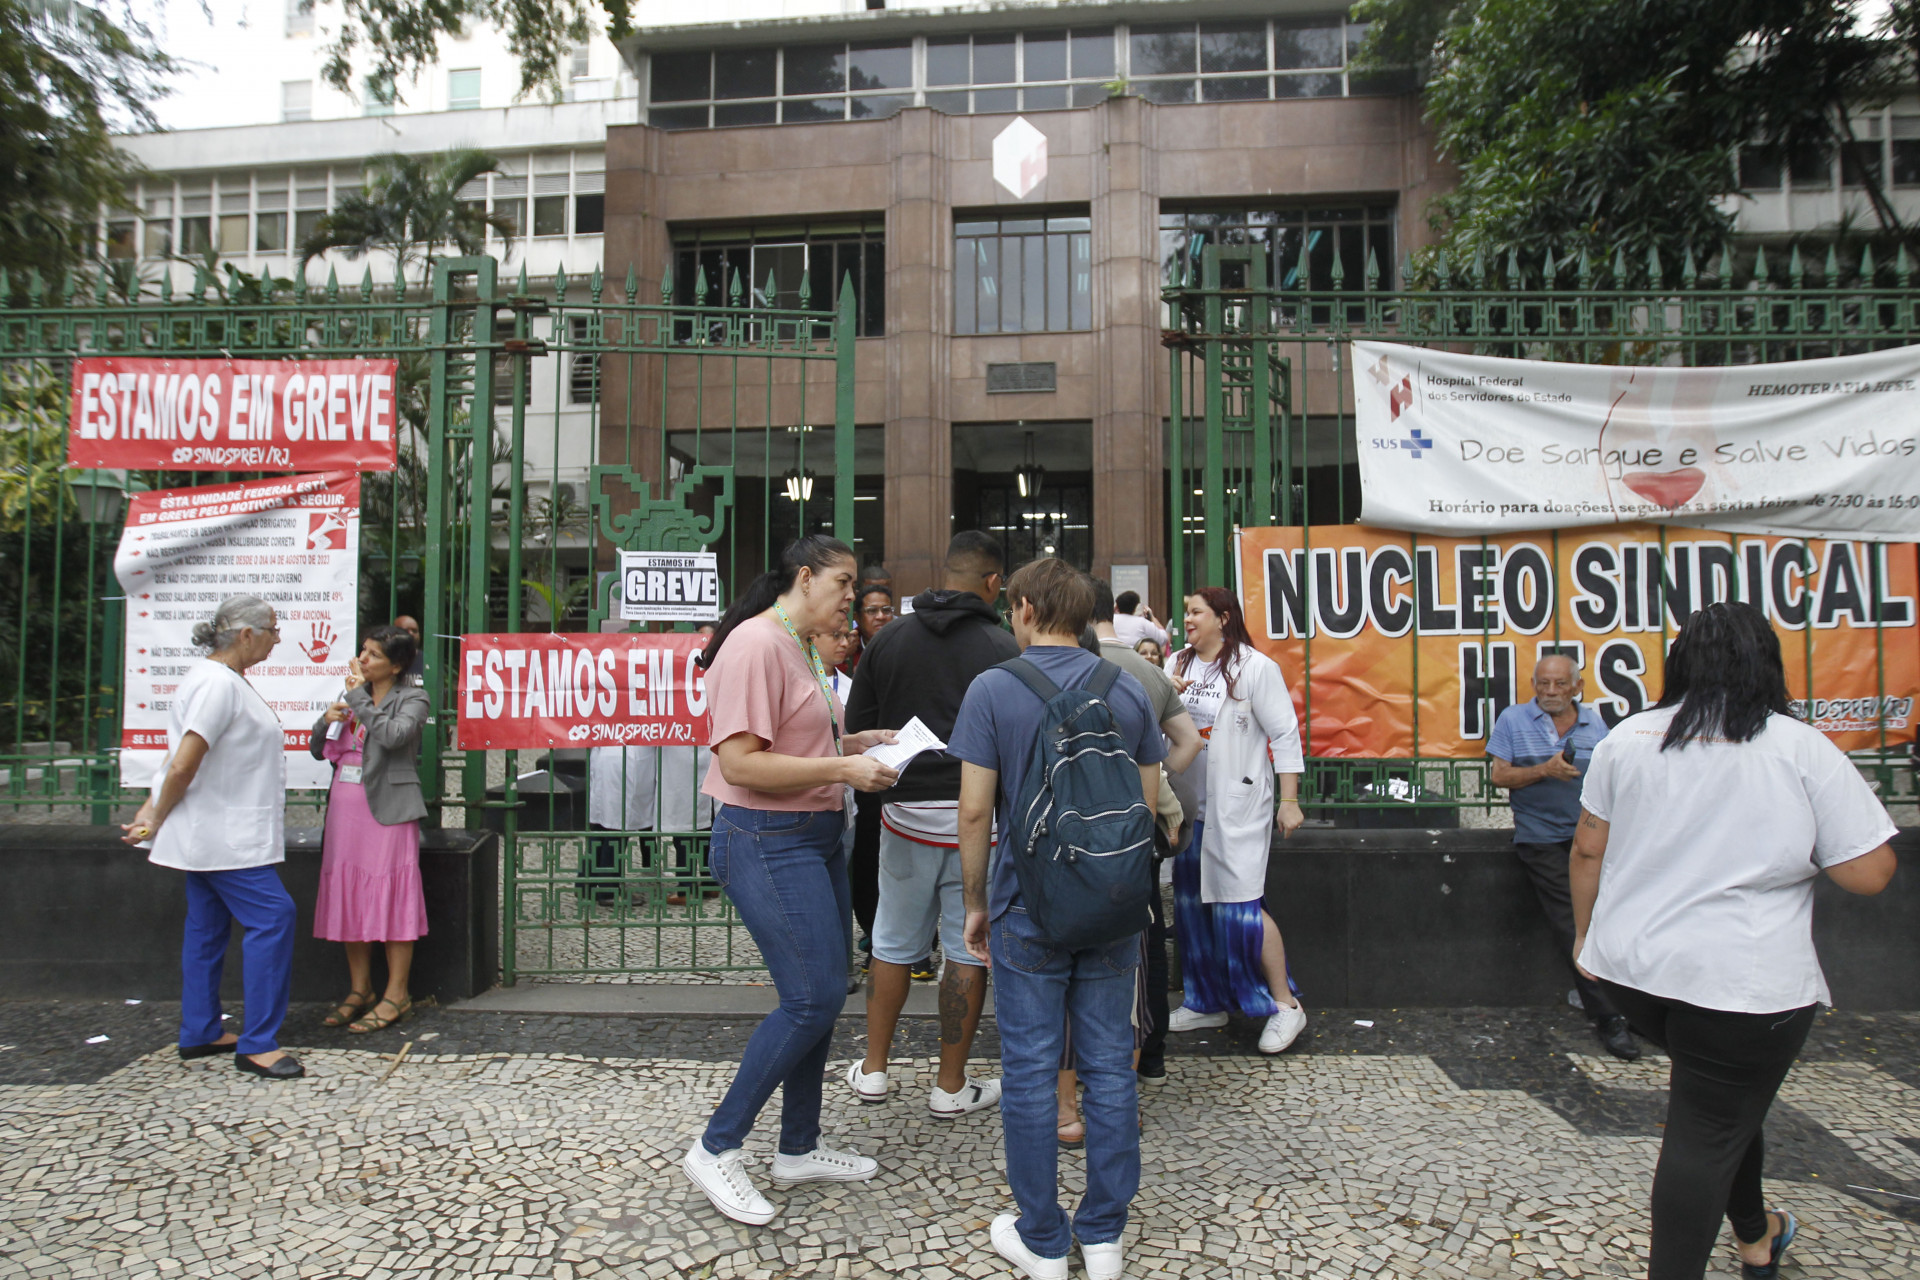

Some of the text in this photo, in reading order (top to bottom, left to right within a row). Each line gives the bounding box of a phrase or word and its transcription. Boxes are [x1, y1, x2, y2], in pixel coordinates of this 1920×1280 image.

[1427, 375, 1523, 388] Hospital Federal
[1747, 381, 1871, 396] HEMOTERAPIA
[1428, 391, 1572, 403] dos Servidores do Estado
[80, 372, 391, 442] ESTAMOS EM GREVE
[1372, 438, 1398, 449] SUS
[1460, 429, 1917, 480] Doe Sangue e Salve Vidas
[160, 496, 190, 509] ESTA
[192, 489, 242, 506] UNIDADE
[243, 483, 294, 499] FEDERAL
[139, 493, 345, 524] EM GREVE PELO MOTIVOS A SEGUIR:
[1428, 499, 1495, 513] Horário
[1499, 502, 1539, 517] para
[1543, 498, 1615, 517] doações:
[1828, 494, 1863, 508] 7:30
[228, 536, 269, 547] INSALUBRIDADE
[270, 536, 296, 547] CORRETA
[216, 554, 234, 566] GREVE
[235, 554, 253, 565] DESDE
[259, 554, 269, 565] DIA
[277, 554, 284, 565] DE
[286, 554, 307, 566] AGOSTO
[308, 554, 316, 565] DE
[317, 554, 330, 565] 2023
[648, 558, 695, 568] ESTAMOS EM
[154, 573, 167, 584] QUE
[168, 571, 179, 584] NÃO
[180, 573, 190, 584] FOI
[190, 573, 218, 584] CUMPRIDO
[219, 573, 228, 584] UM
[246, 572, 260, 584] ITEM
[261, 573, 275, 584] PELO
[275, 573, 302, 583] GOVERNO
[626, 569, 717, 603] GREVE
[1263, 538, 1915, 640] NUCLEO SINDICAL
[294, 592, 302, 602] NA
[303, 592, 322, 602] ORDEM
[322, 592, 330, 602] DE
[331, 591, 344, 602] 49%
[275, 609, 289, 620] ERAL
[290, 610, 300, 621] SEM
[302, 610, 332, 621] ADICIONAL
[162, 646, 181, 657] TEMOS
[267, 665, 287, 676] MESMO
[287, 665, 305, 676] ASSIM
[305, 665, 351, 676] TRABALHADORES
[466, 648, 618, 720] ESTAMOS
[628, 648, 674, 717] EM
[279, 701, 310, 711] ENTREGUE
[310, 701, 316, 711] A
[132, 734, 145, 745] SE
[145, 734, 153, 745] A
[299, 731, 306, 745] É
